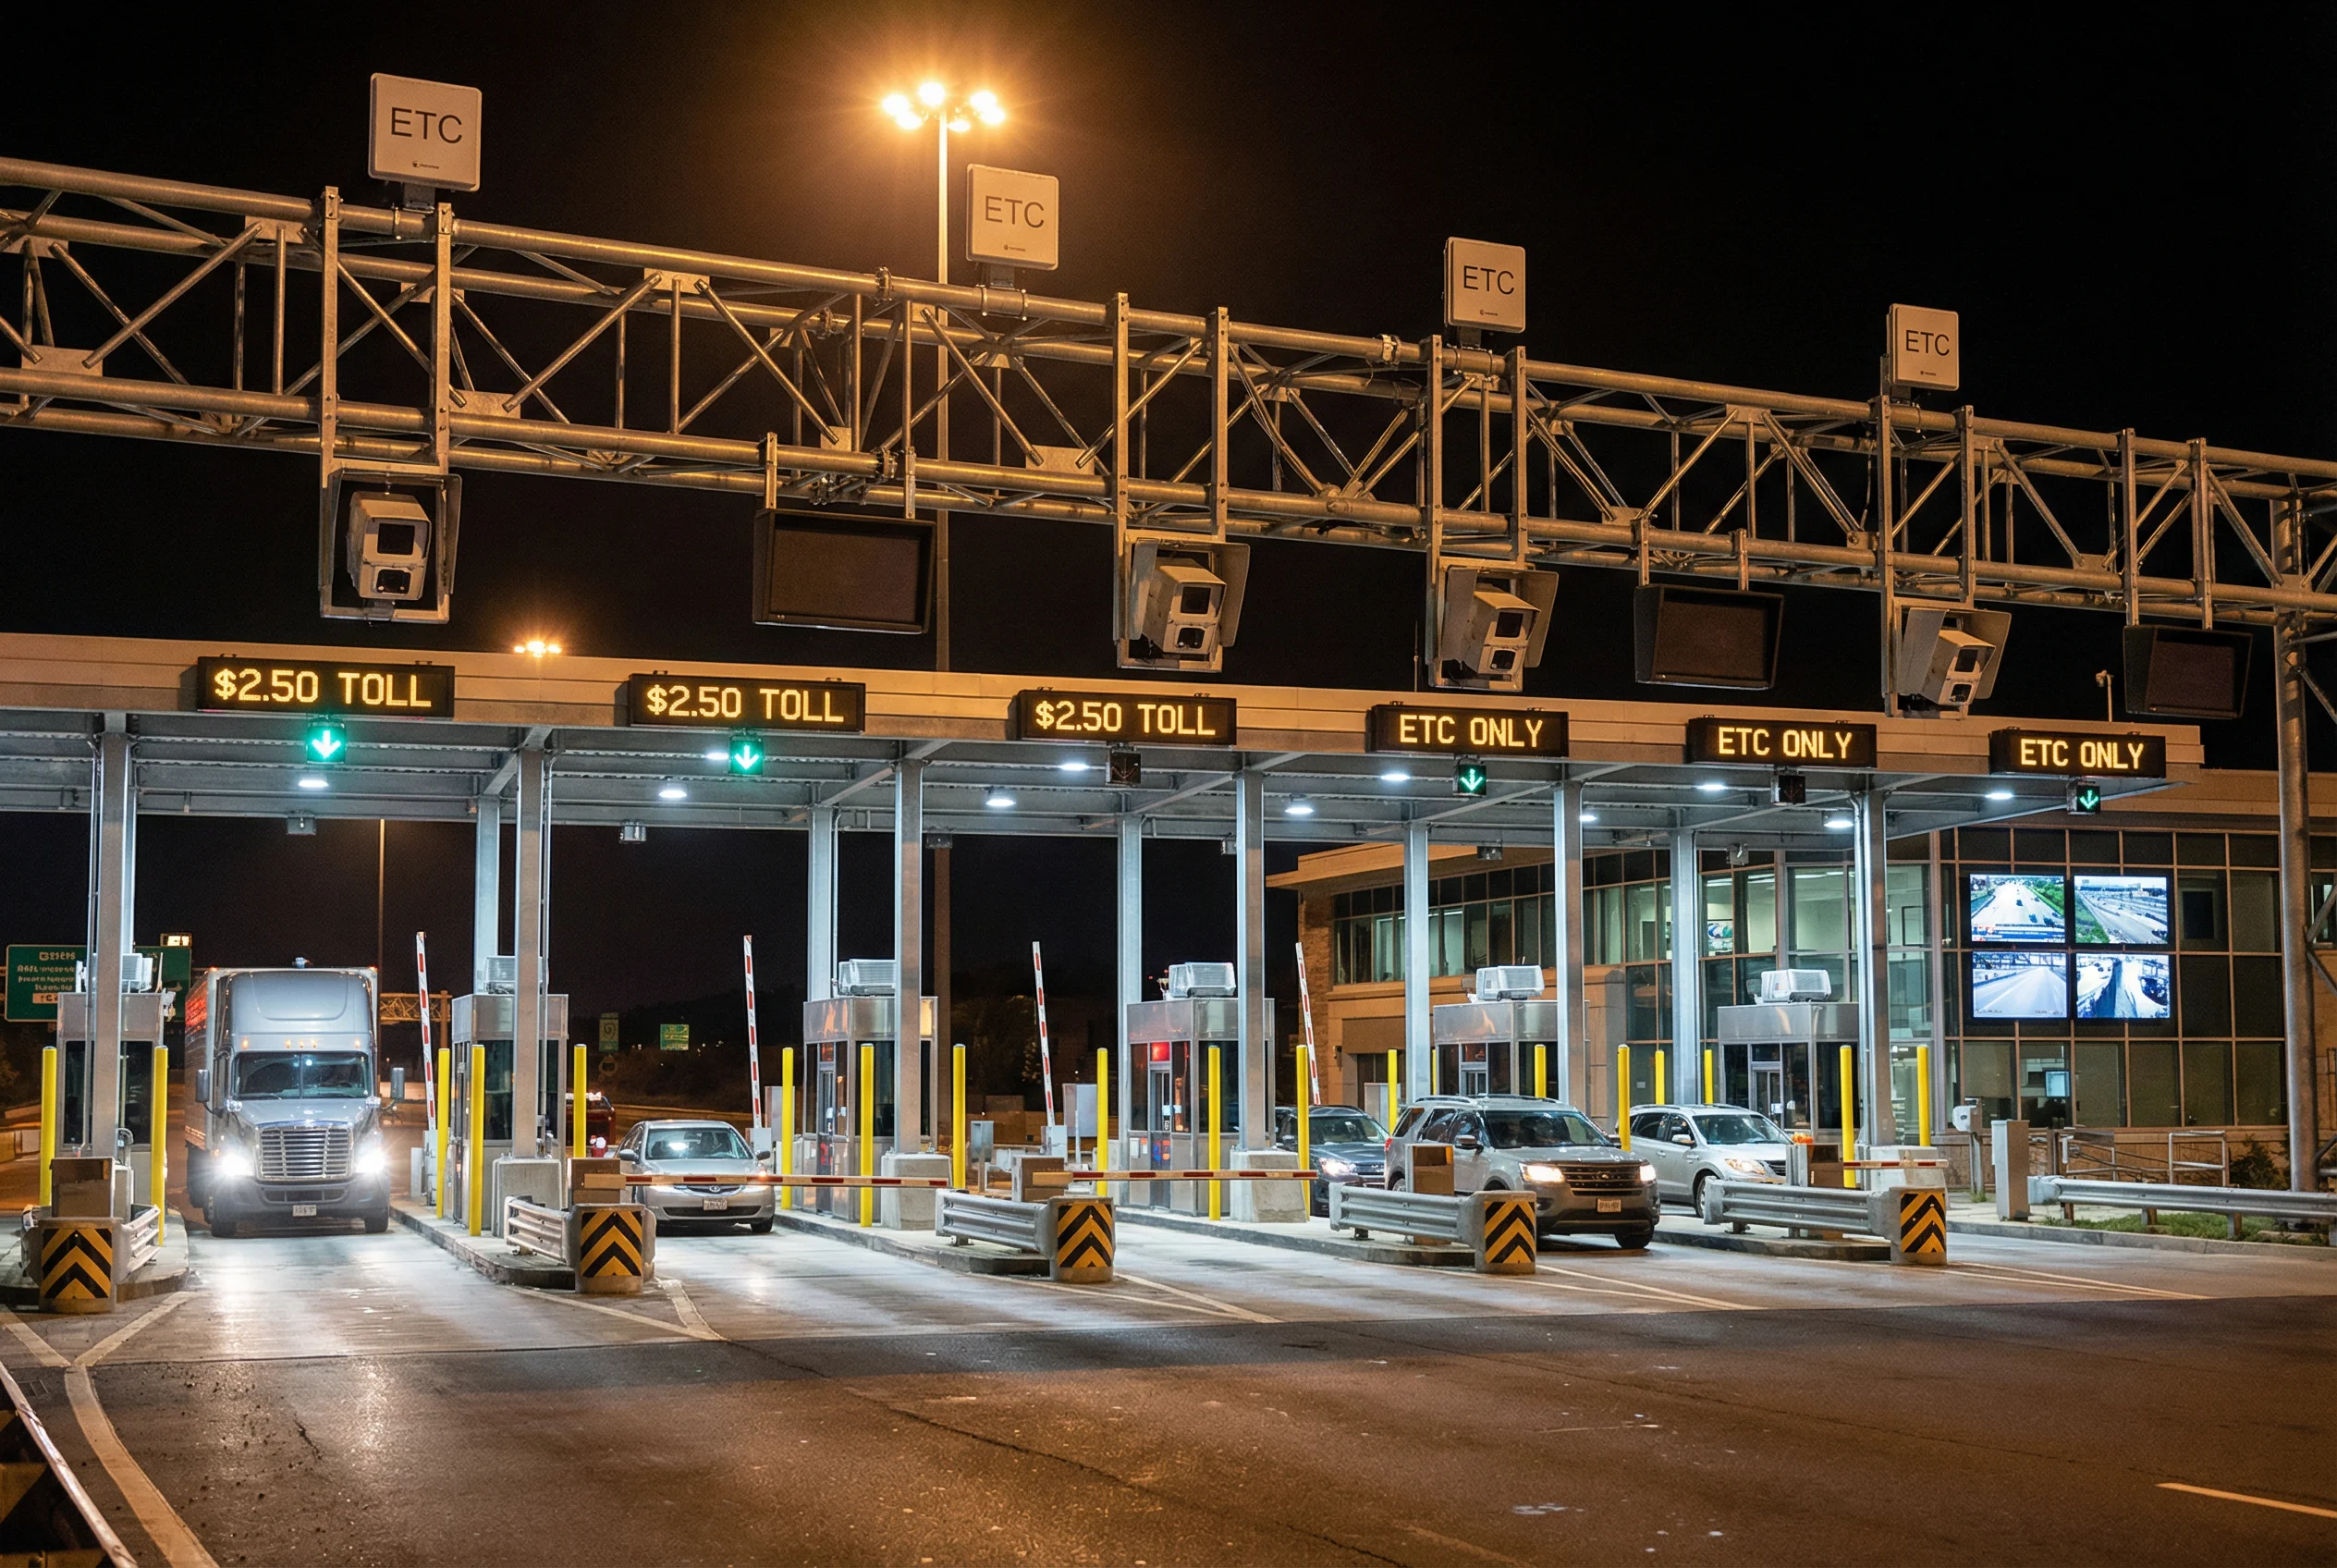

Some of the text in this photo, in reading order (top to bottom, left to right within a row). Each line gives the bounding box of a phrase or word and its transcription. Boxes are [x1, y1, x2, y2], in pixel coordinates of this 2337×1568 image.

[391, 106, 462, 144] ETC
[985, 195, 1045, 228] ETC
[1463, 265, 1514, 295] ETC
[1906, 329, 1950, 356] ETC
[214, 668, 432, 707] $2.50 TOLL
[646, 684, 844, 722] $2.50 TOLL
[1035, 700, 1216, 736] $2.50 TOLL
[1400, 714, 1543, 748] ETC ONLY
[1719, 726, 1853, 759] ETC ONLY
[2021, 738, 2145, 769] ETC ONLY
